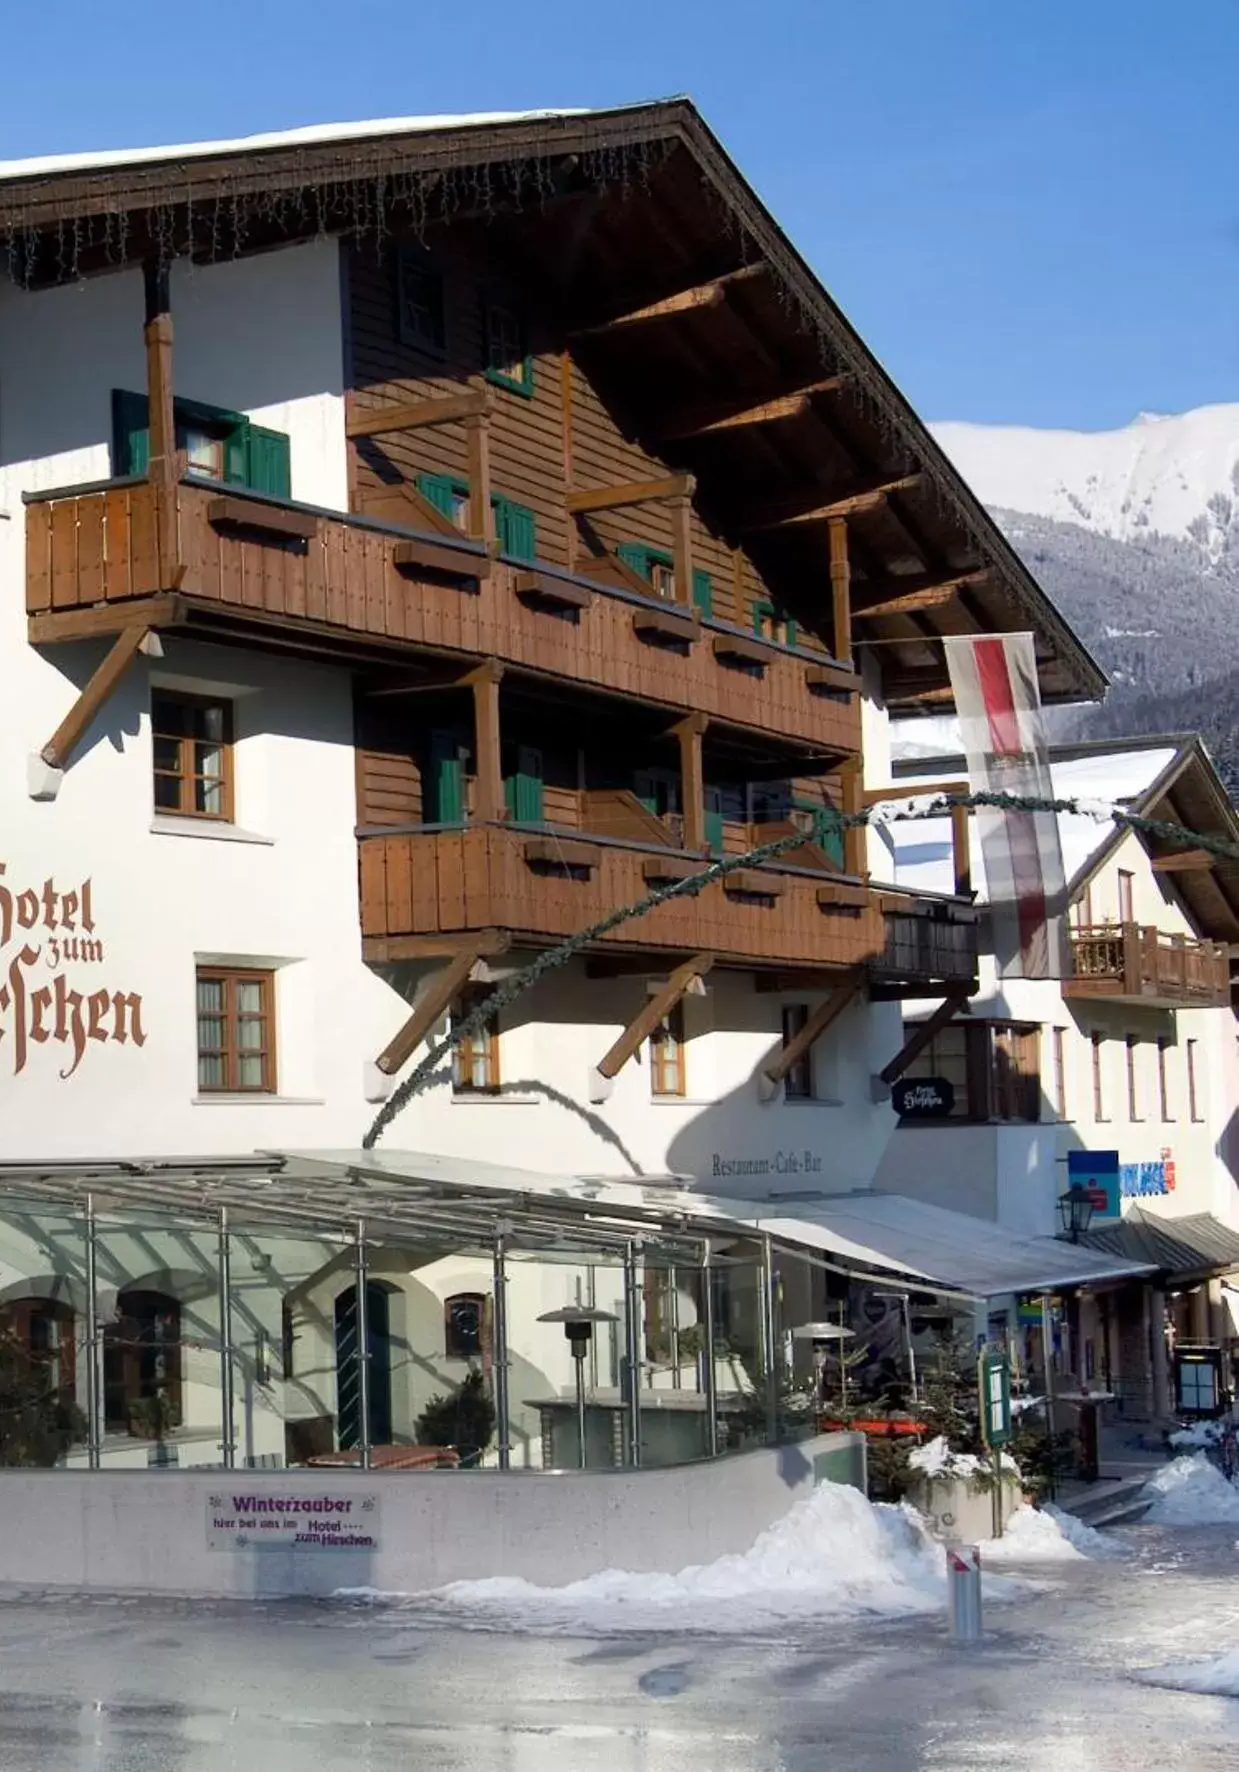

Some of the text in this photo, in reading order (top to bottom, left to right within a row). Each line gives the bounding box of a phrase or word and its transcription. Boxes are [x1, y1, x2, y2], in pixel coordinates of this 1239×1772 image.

[46, 936, 103, 969] zum
[232, 1496, 352, 1512] Winterzauber
[308, 1520, 341, 1531] Hotel
[294, 1533, 372, 1548] zum Hirschen
